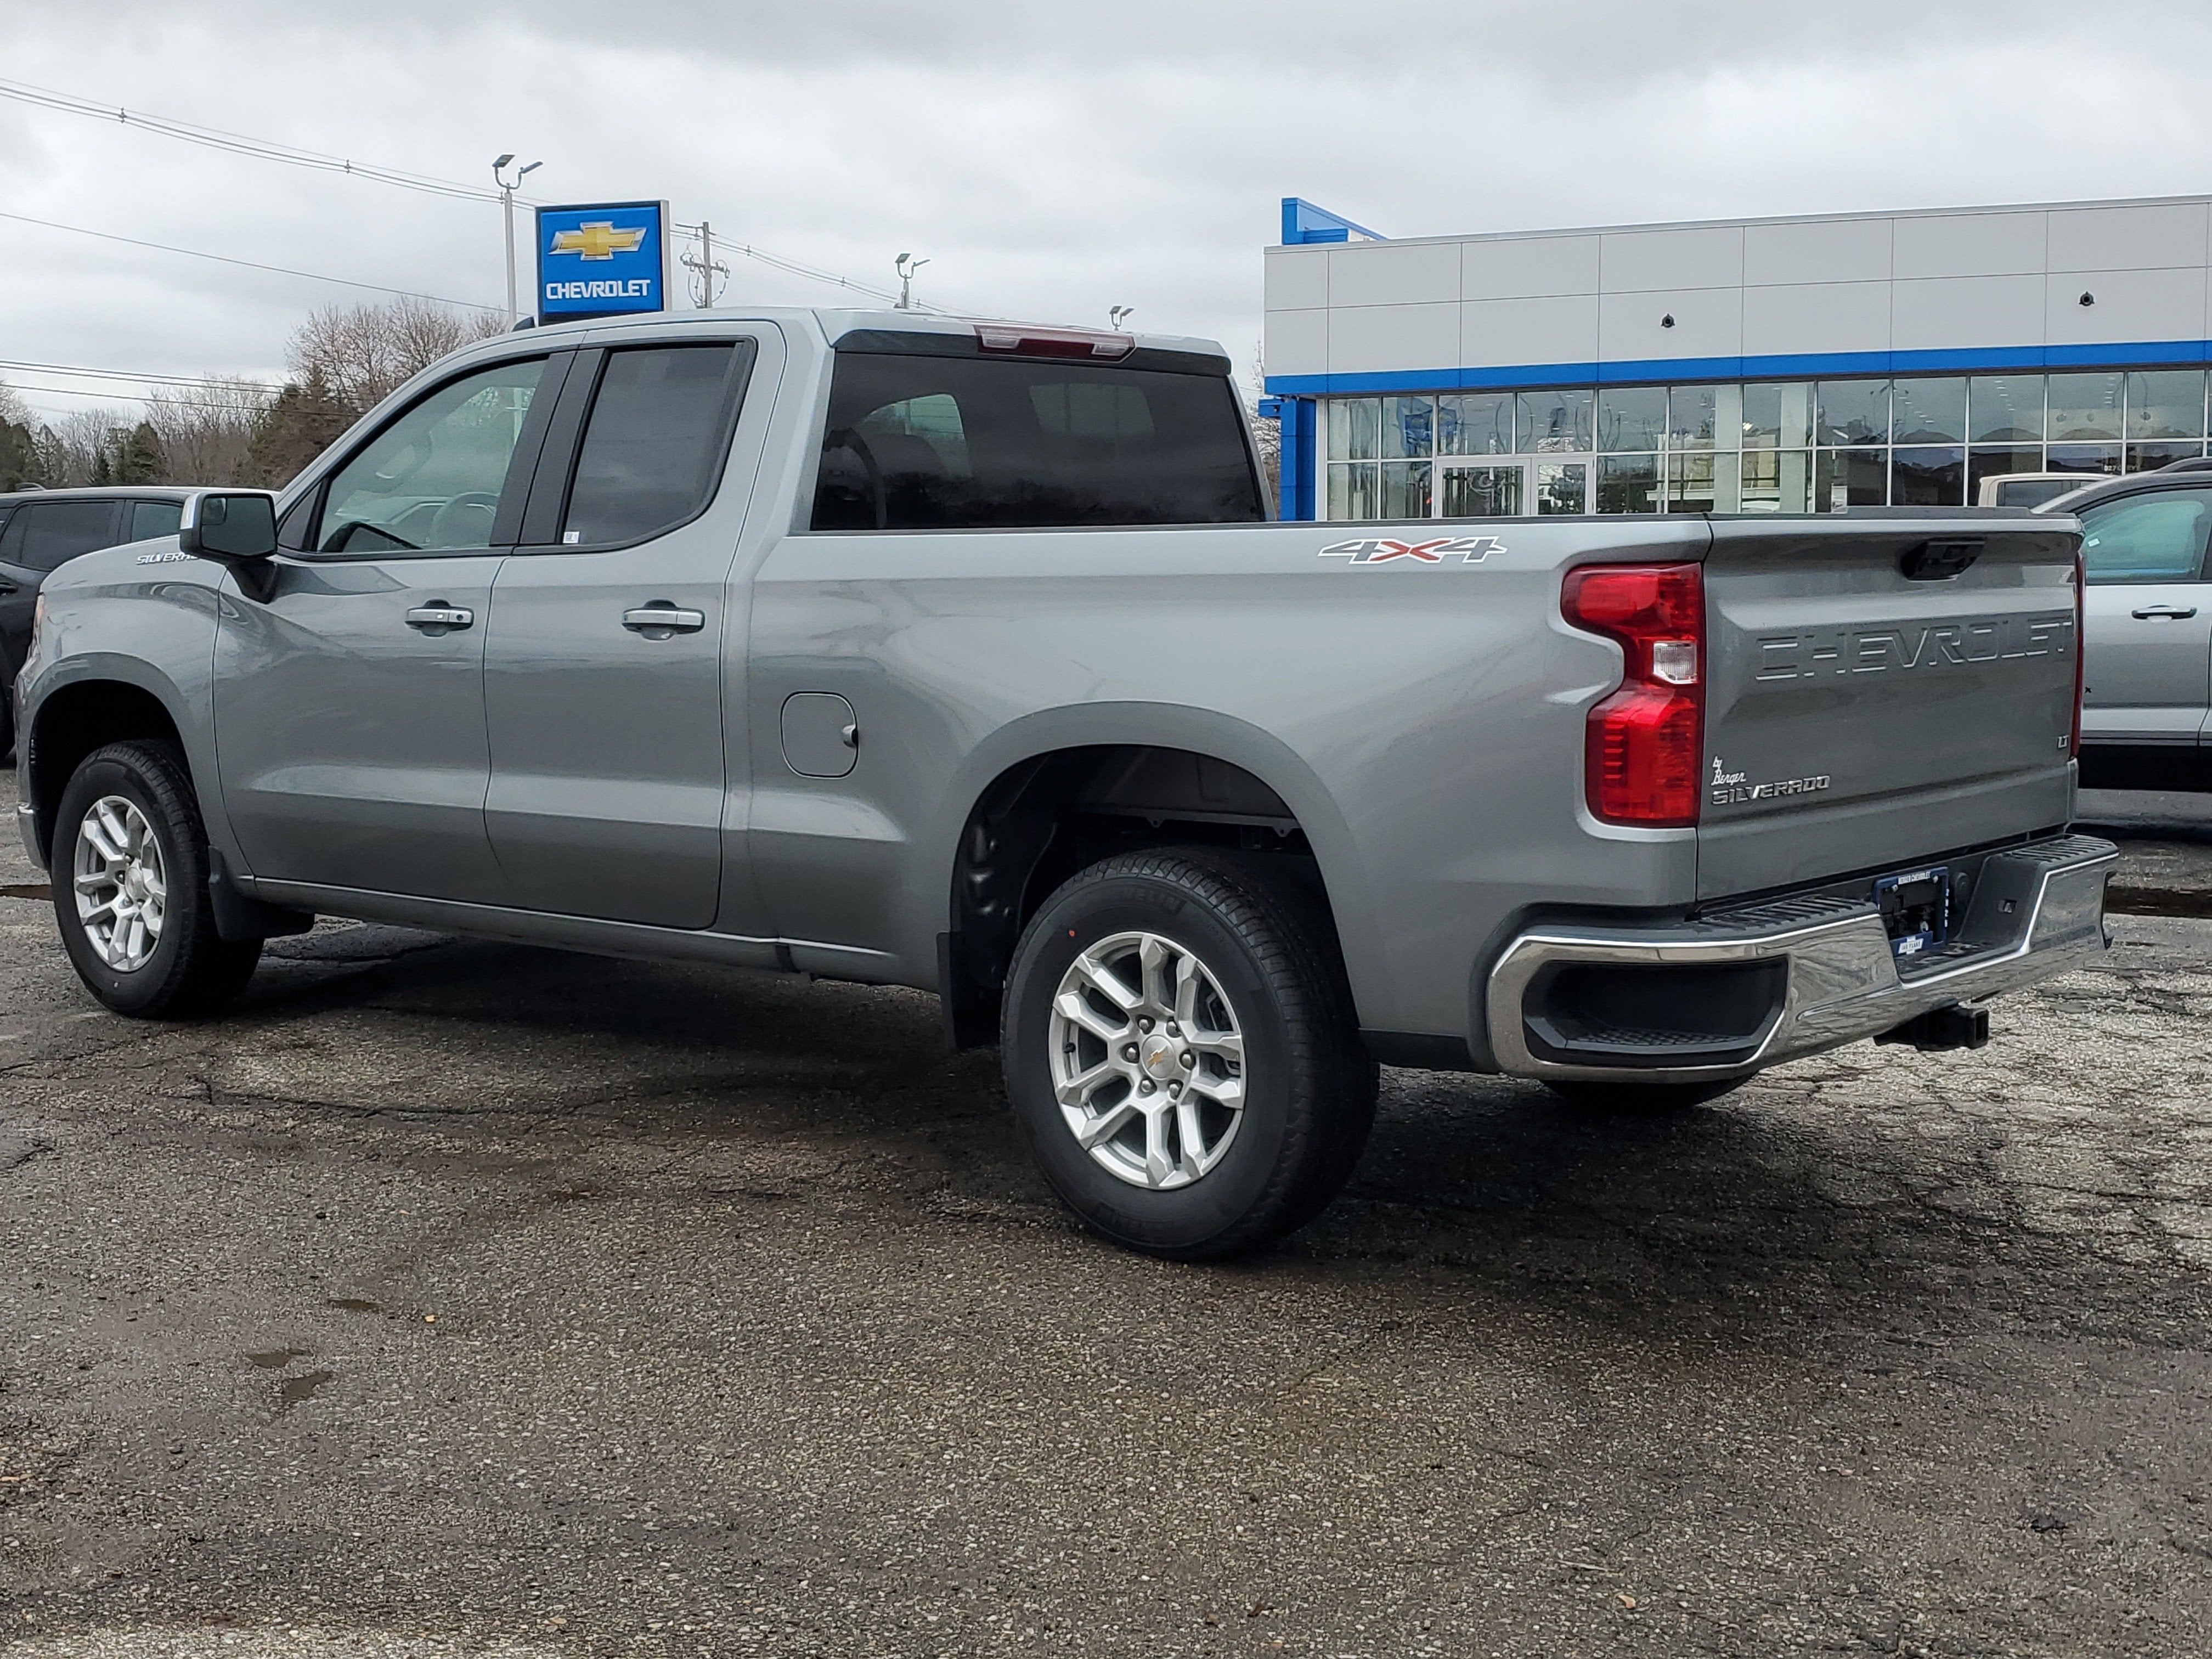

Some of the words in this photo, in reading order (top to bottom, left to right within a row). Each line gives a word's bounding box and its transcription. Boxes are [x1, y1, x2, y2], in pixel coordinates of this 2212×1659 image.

[546, 279, 651, 300] CHEVROLET
[1756, 614, 2073, 680] CHEVROLET
[1712, 756, 1723, 769] by
[1711, 770, 1746, 787] Berger
[1712, 775, 1830, 805] SILVERADO
